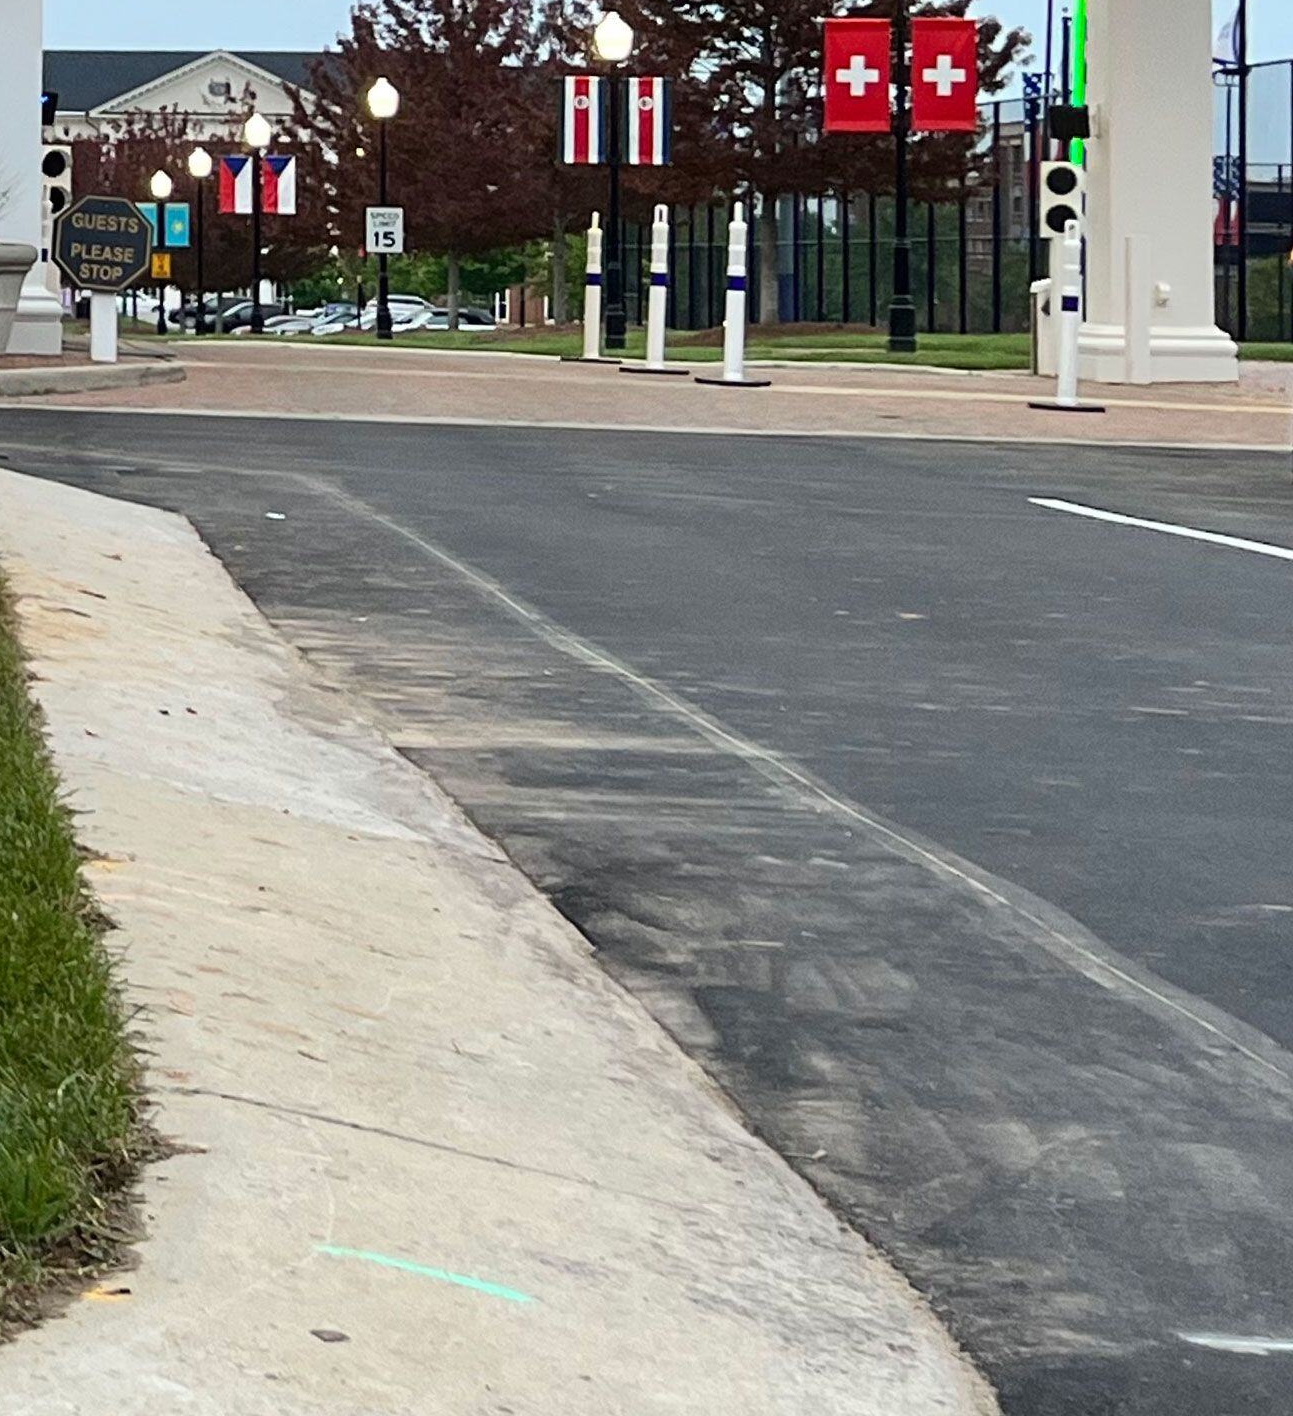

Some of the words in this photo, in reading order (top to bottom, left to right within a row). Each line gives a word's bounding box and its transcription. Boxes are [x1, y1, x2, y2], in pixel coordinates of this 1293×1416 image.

[72, 212, 139, 234] GUESTS
[373, 230, 396, 248] 15
[70, 242, 135, 264] PLEASE
[79, 262, 123, 281] STOP
